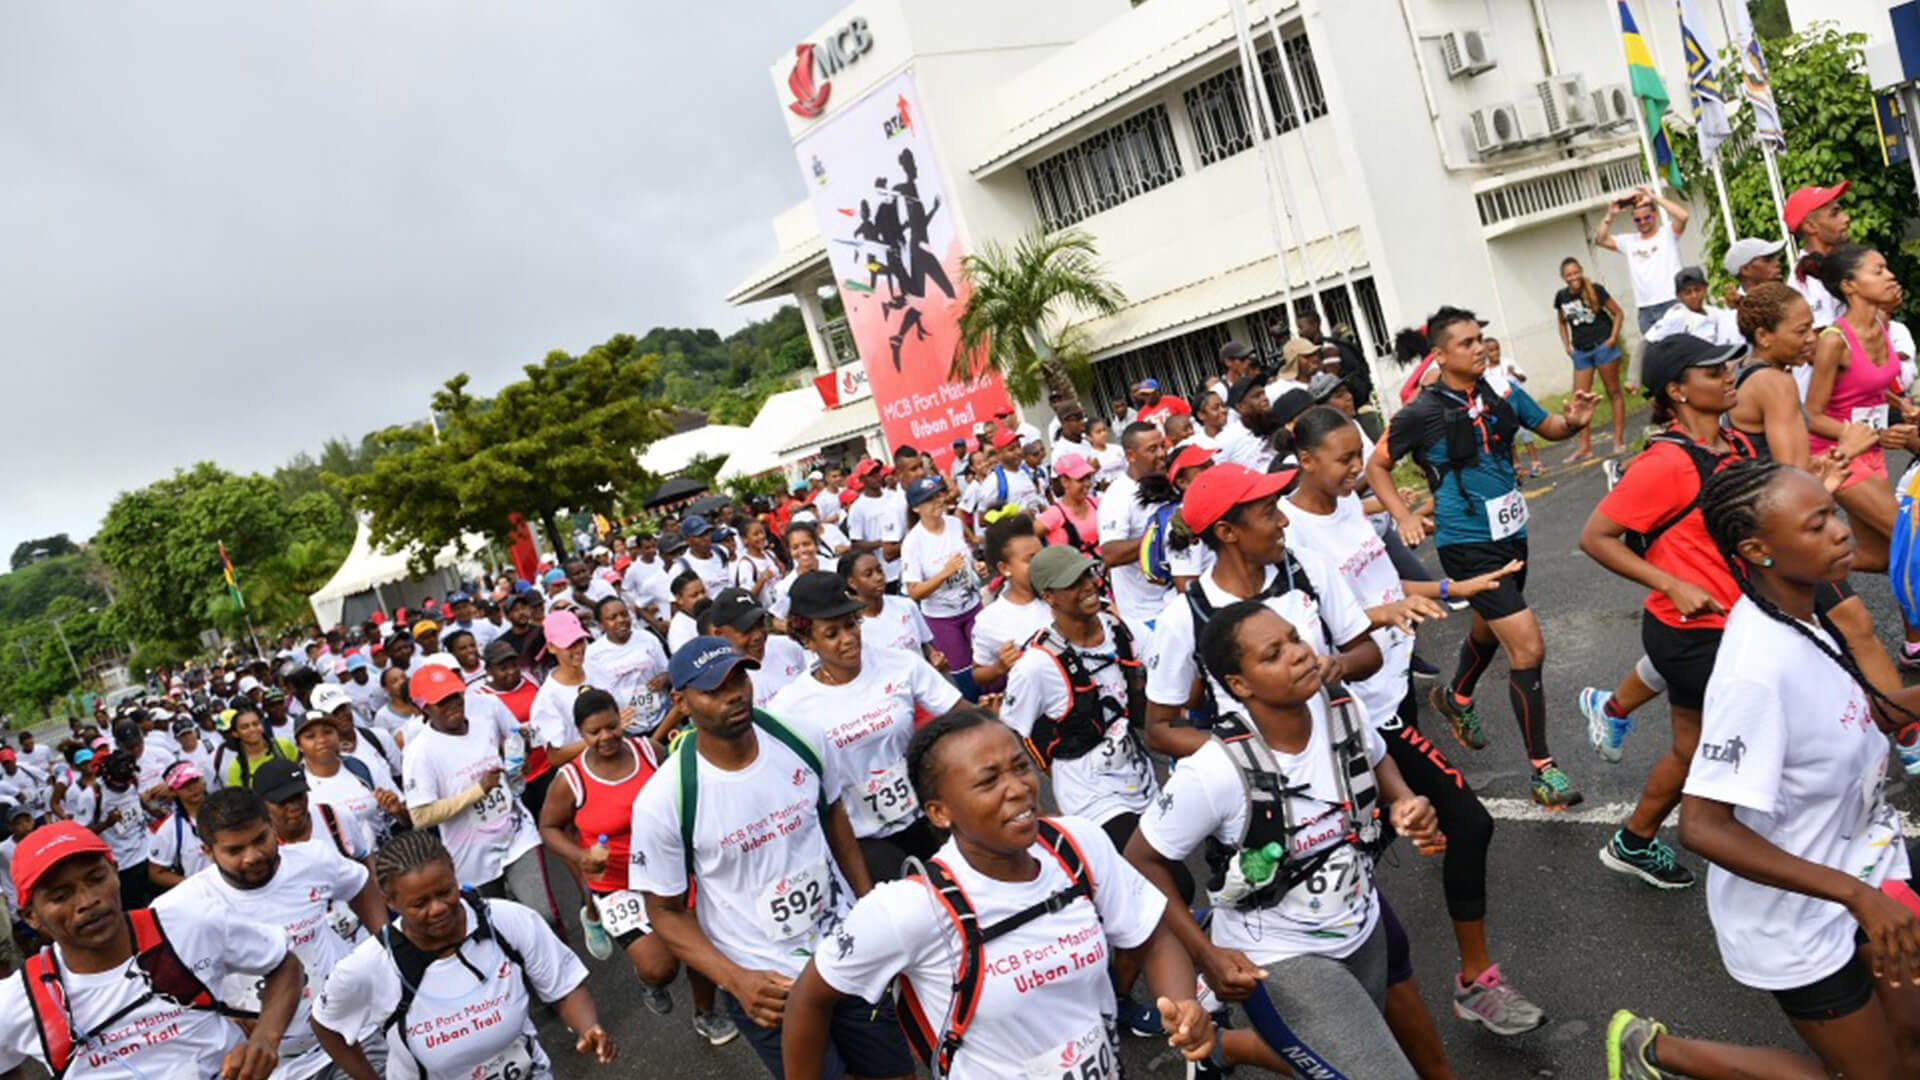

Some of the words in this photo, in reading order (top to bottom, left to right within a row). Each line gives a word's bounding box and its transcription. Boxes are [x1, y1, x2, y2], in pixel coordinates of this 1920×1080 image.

[813, 16, 874, 79] MCB
[883, 397, 912, 421] MCB
[912, 393, 939, 412] Port
[910, 418, 948, 439] Urban
[946, 401, 976, 428] Trail
[863, 777, 909, 812] 735
[741, 832, 776, 853] Urban
[777, 815, 802, 836] Trail
[606, 898, 640, 925] 339
[770, 880, 823, 922] 592
[1014, 965, 1068, 993] Urban
[1070, 941, 1104, 970] Trail
[1022, 944, 1058, 964] Port
[142, 1022, 180, 1046] Trail
[425, 1028, 470, 1049] Urban
[471, 1009, 502, 1031] Trail
[1282, 1046, 1335, 1080] NEW
